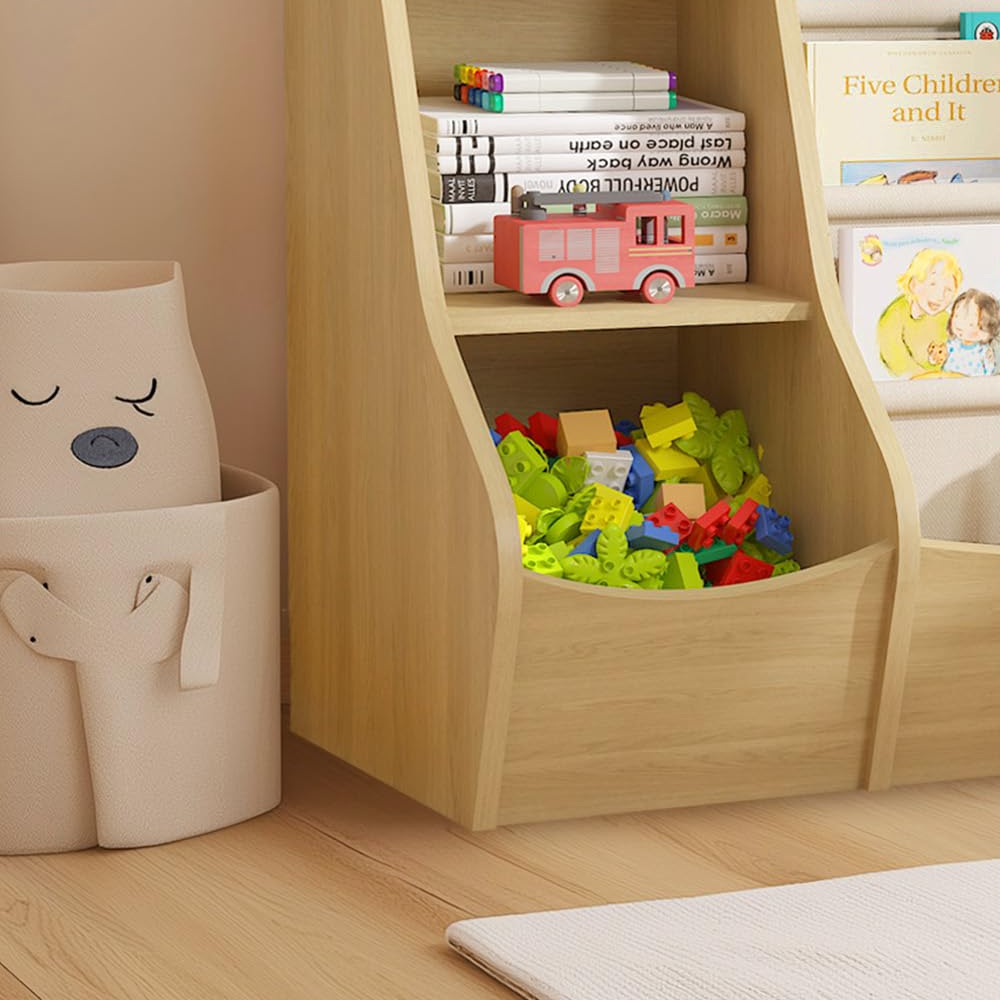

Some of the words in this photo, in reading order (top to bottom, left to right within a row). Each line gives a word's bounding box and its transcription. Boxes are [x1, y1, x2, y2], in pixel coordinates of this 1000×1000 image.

[843, 74, 896, 96] Five
[892, 101, 940, 123] and
[948, 102, 966, 121] It
[639, 123, 662, 131] lived
[663, 123, 682, 131] who
[682, 123, 704, 131] Man
[569, 140, 613, 152] earth
[619, 140, 640, 151] on
[646, 137, 695, 151] place
[700, 137, 732, 150] Last
[587, 156, 632, 170] back
[637, 155, 672, 169] way
[678, 154, 732, 168] Wrong
[604, 176, 699, 193] POWERFULL
[700, 209, 742, 220] Macro
